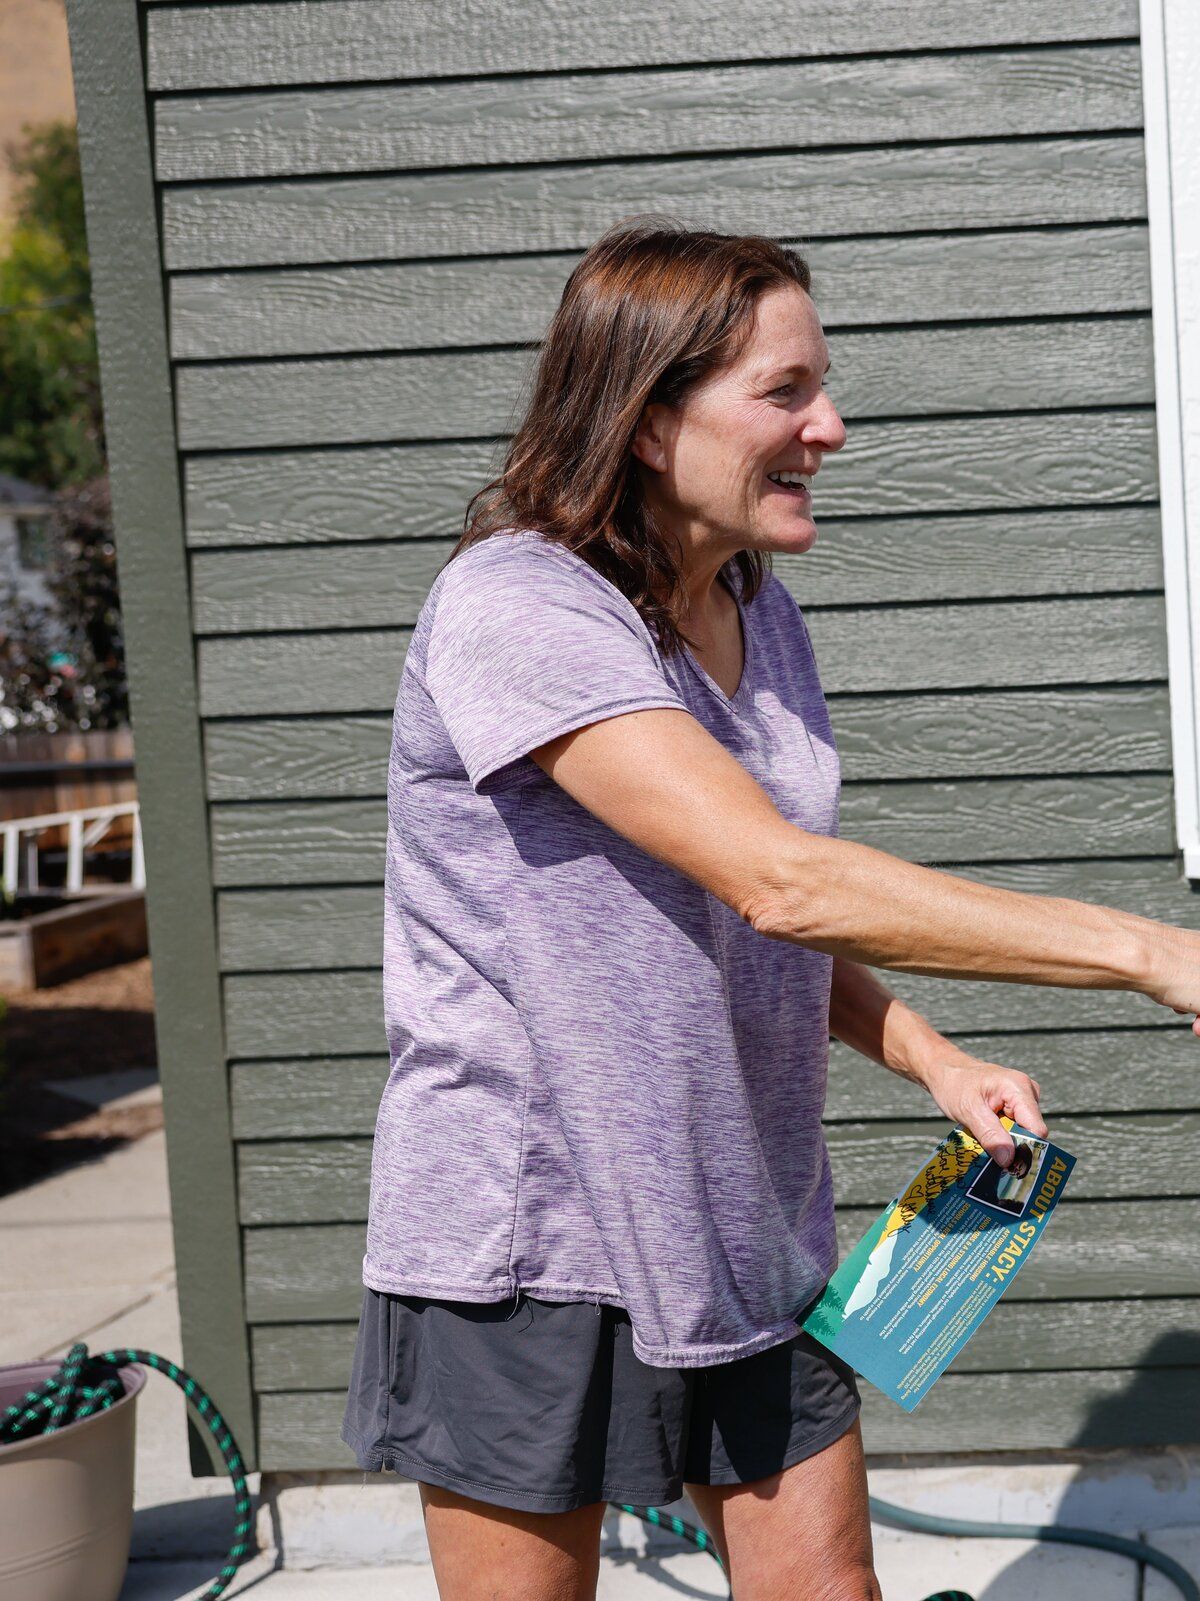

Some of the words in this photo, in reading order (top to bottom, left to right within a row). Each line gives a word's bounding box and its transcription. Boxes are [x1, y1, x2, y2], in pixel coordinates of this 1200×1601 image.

[1029, 1156, 1067, 1223] ABOUT
[950, 1202, 971, 1224] SCHOOLS
[977, 1216, 992, 1230] GOOD
[937, 1227, 951, 1240] REAL
[968, 1229, 981, 1242] JOBS
[984, 1228, 1012, 1260] AFFORDABLE
[912, 1239, 941, 1271] OPPORTUNITY
[947, 1249, 965, 1269] STRONG
[986, 1221, 1036, 1283] STACY:
[935, 1267, 951, 1284] LOCAL
[968, 1259, 989, 1282] HOUSING
[916, 1282, 939, 1307] ECONOMY
